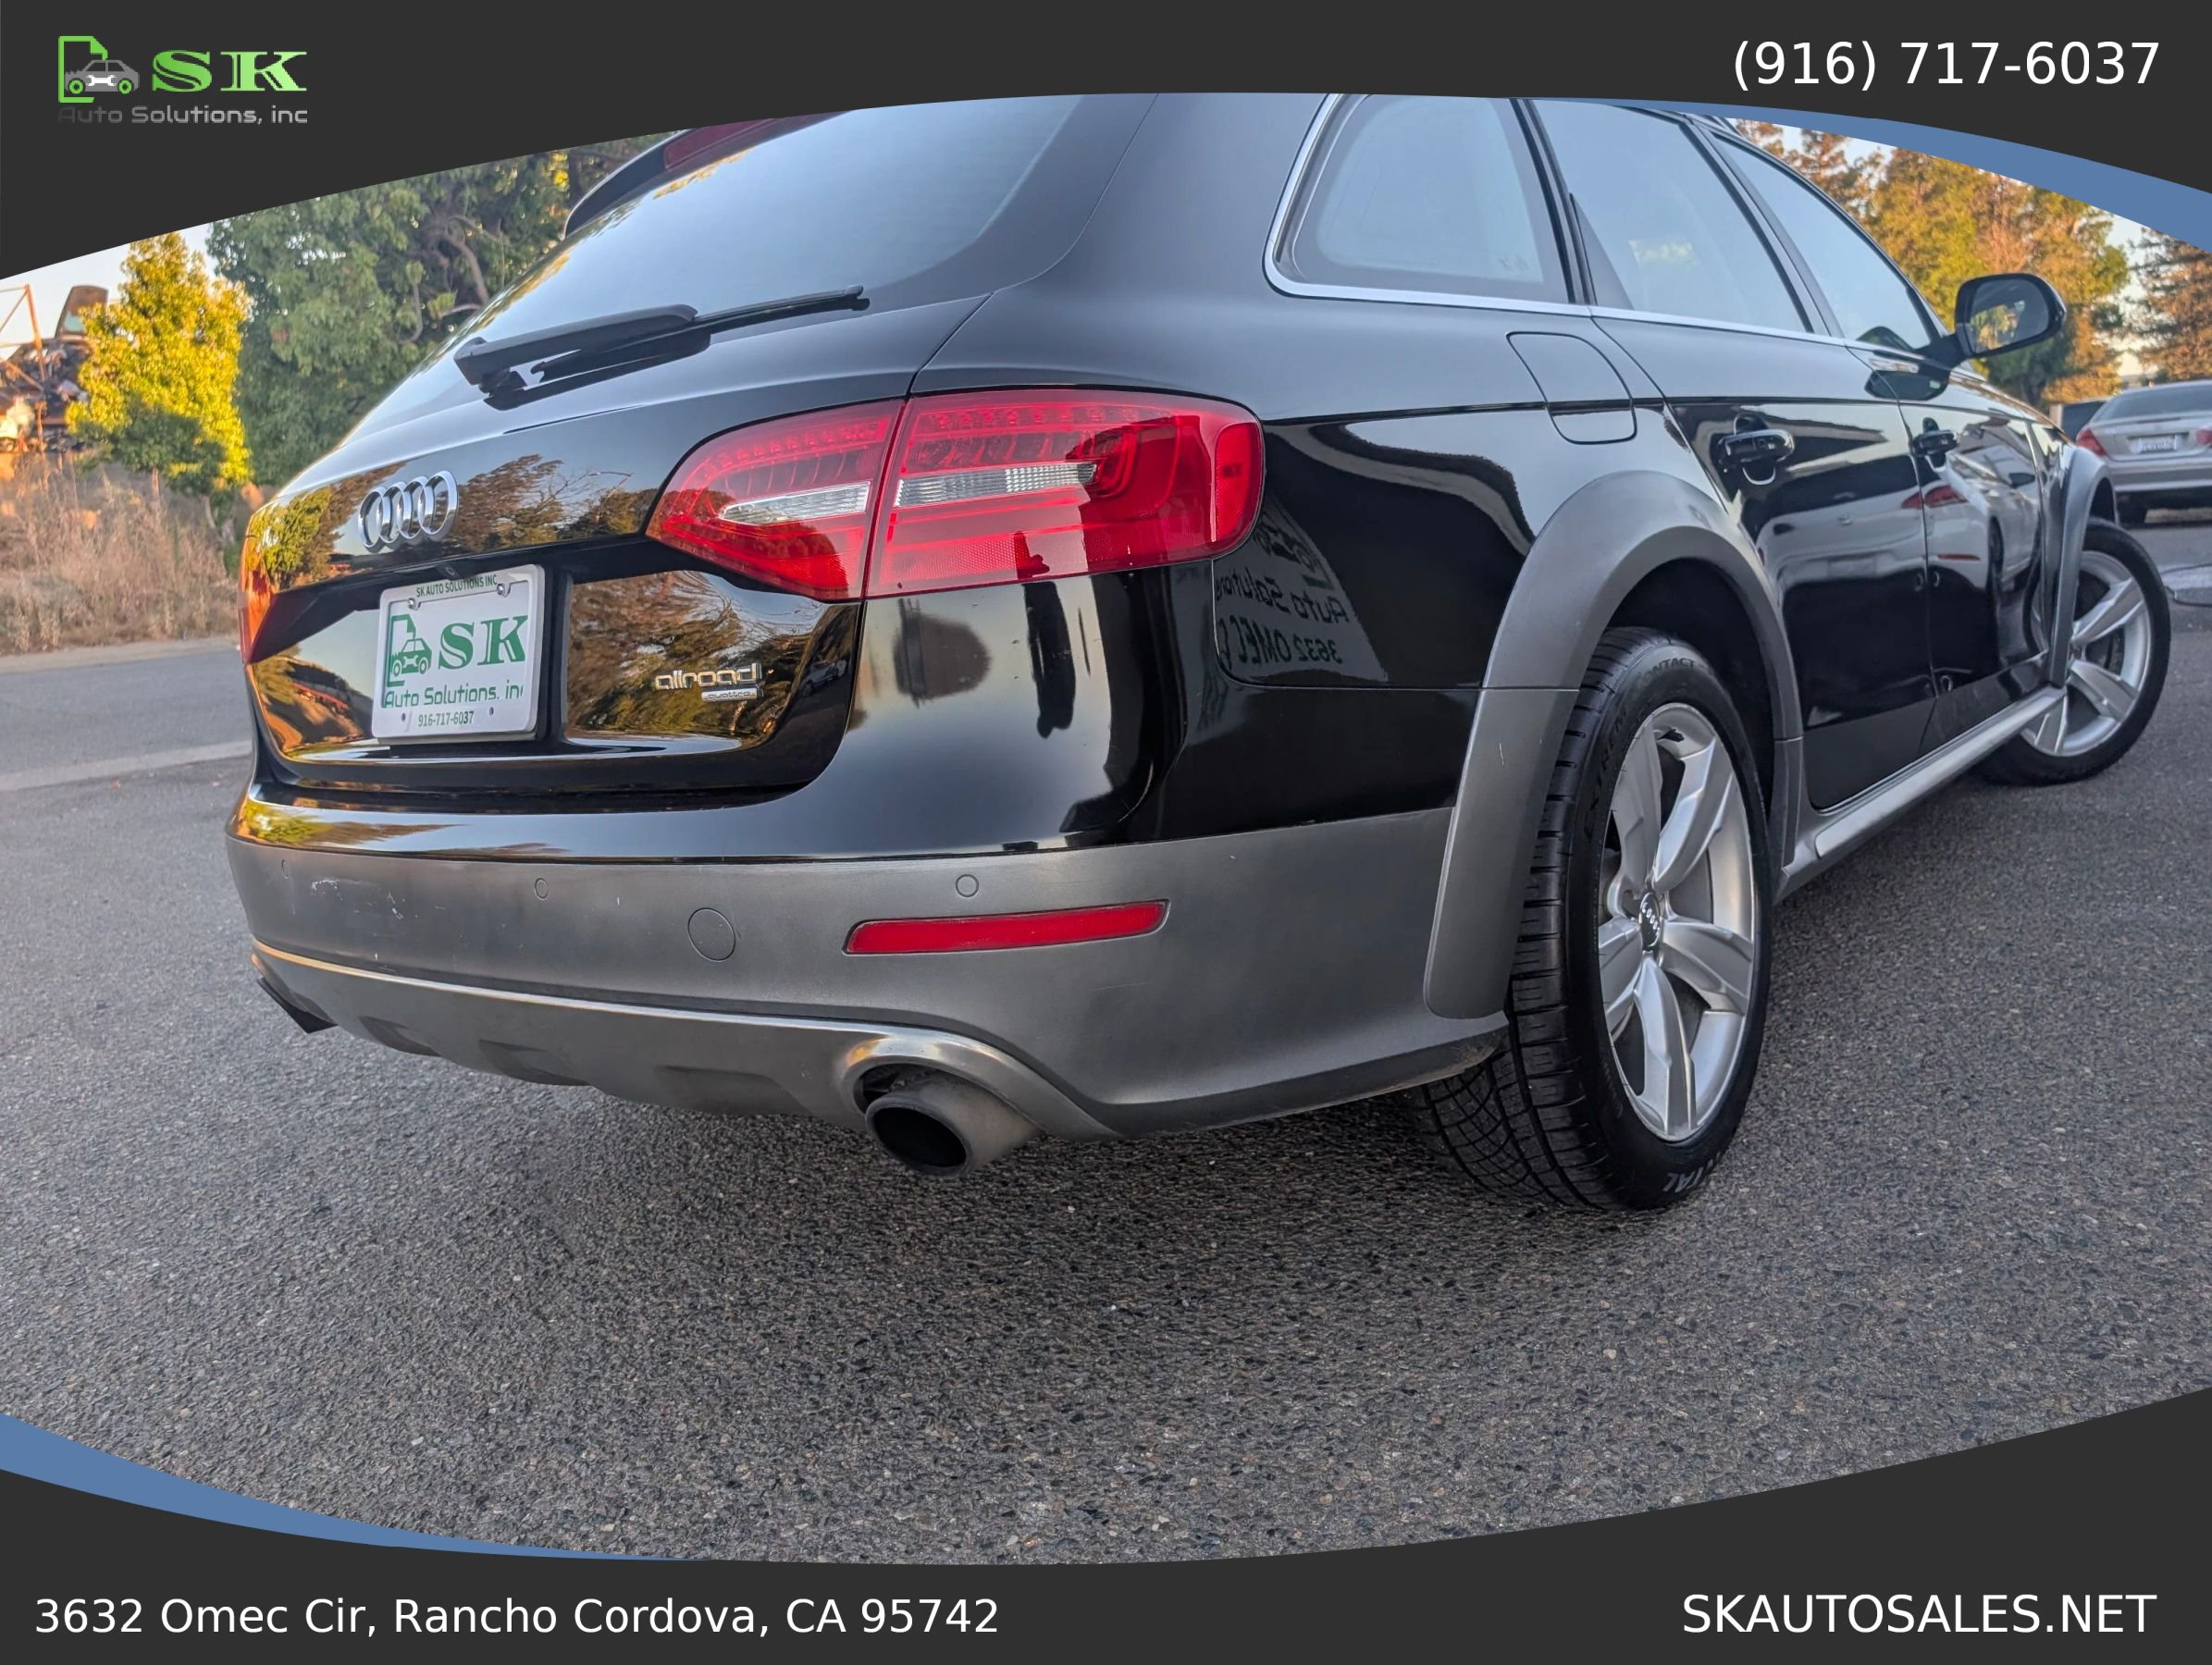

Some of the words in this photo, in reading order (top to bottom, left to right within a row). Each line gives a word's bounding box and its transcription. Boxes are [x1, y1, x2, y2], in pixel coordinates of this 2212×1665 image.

[415, 586, 426, 598] SK
[426, 583, 444, 596] AUTO
[445, 576, 484, 593] SOLUTIONS
[485, 574, 498, 586] INC
[438, 614, 529, 670] SK
[655, 662, 762, 690] allroad
[384, 688, 420, 709] Auto
[417, 710, 475, 727] 916-717-6037
